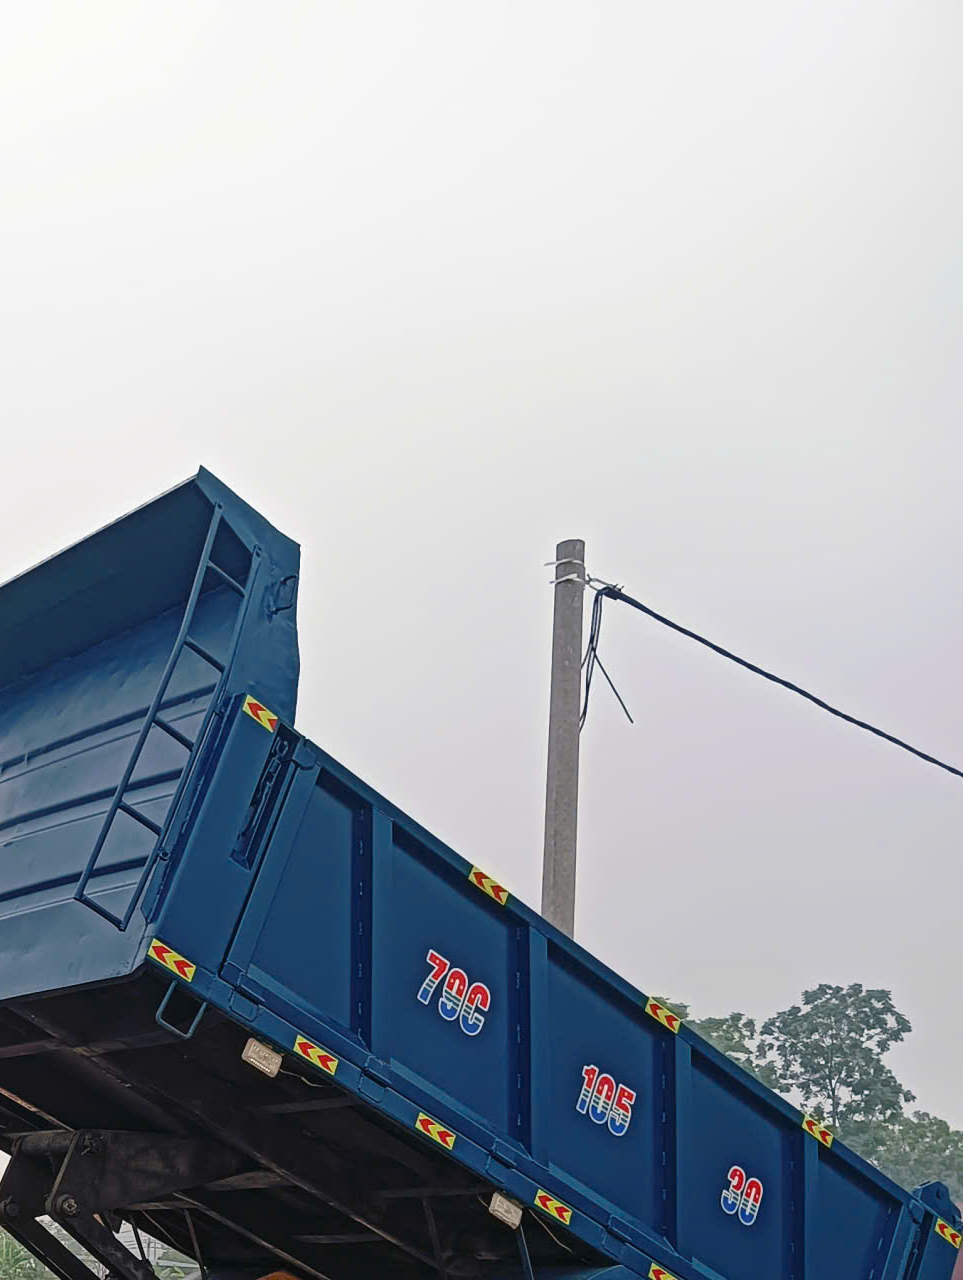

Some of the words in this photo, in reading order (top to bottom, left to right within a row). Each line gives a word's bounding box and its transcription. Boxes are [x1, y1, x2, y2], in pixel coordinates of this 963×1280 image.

[417, 949, 491, 1036] 79C
[576, 1064, 636, 1137] 105
[720, 1165, 764, 1226] 30
